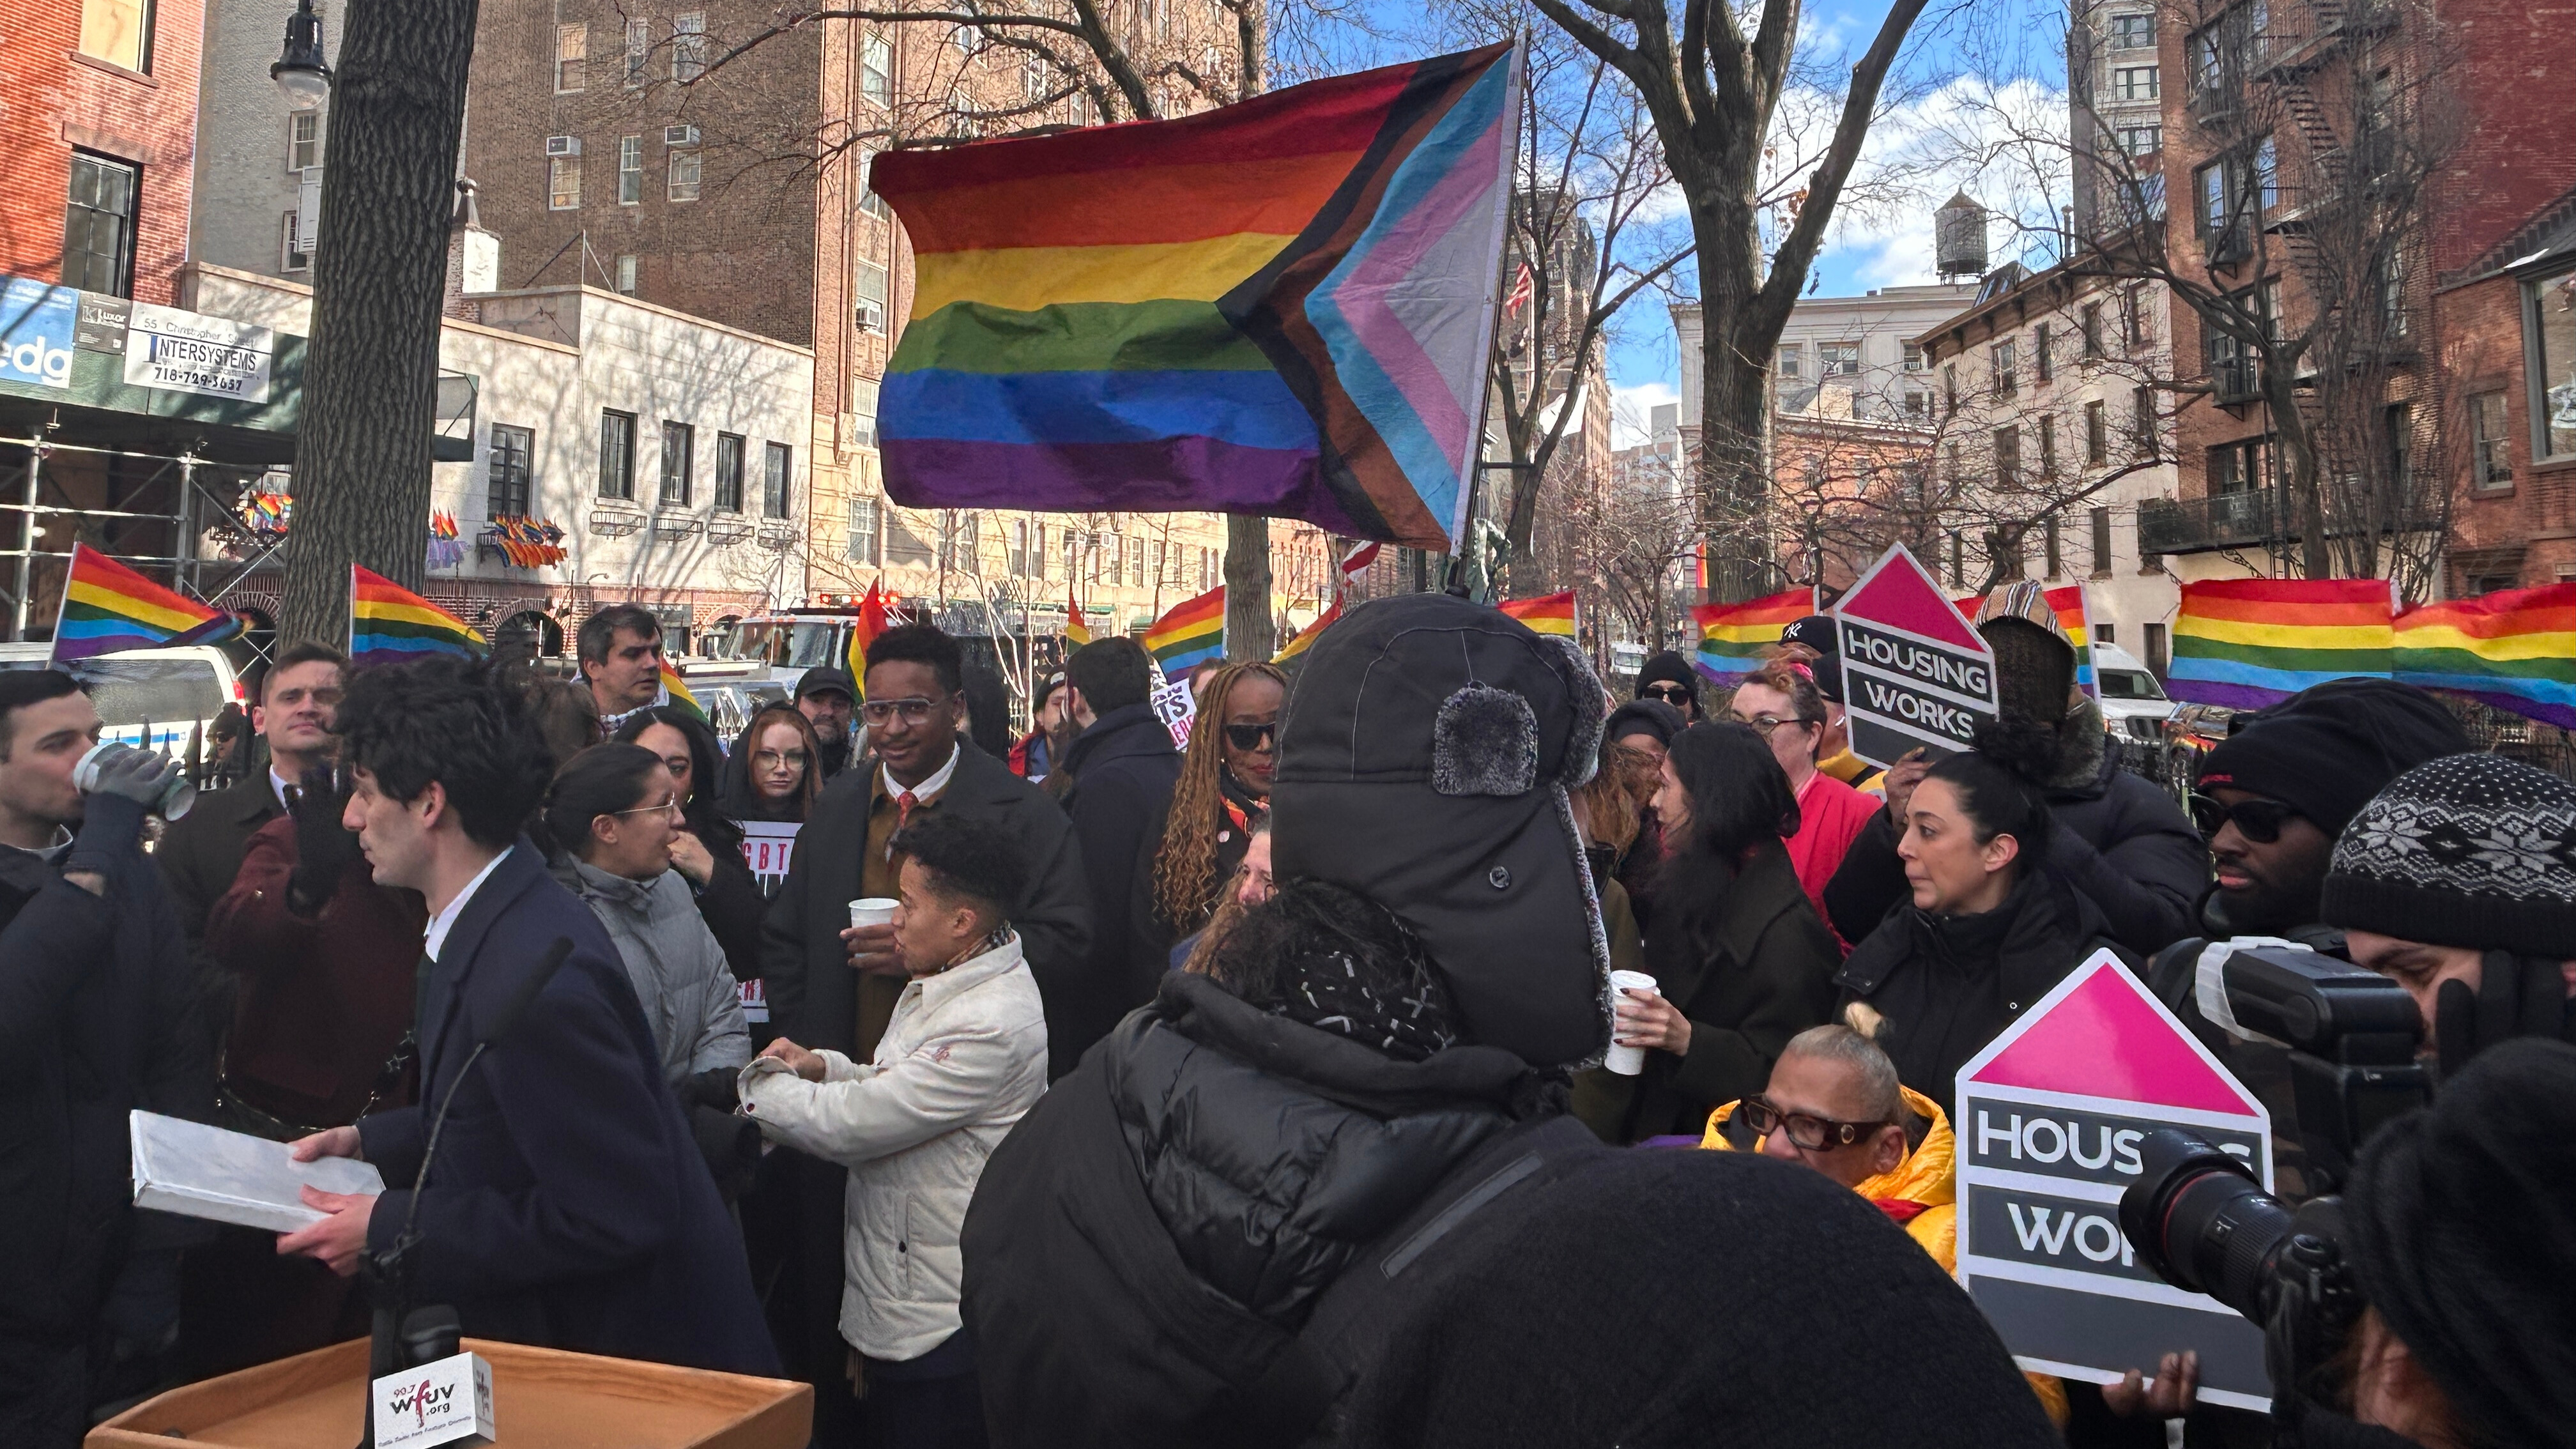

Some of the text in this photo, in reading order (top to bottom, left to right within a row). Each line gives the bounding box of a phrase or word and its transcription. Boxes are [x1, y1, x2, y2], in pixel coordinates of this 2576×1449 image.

[143, 334, 257, 371] INTERSYSTEMS
[144, 318, 158, 329] 55
[166, 322, 222, 341] Christopher
[1848, 629, 1988, 694] HOUSING
[1154, 694, 1188, 725] TS
[1864, 680, 1975, 739] WORKS
[1977, 1110, 2253, 1176] HOUS
[2006, 1202, 2135, 1267] WO
[426, 1402, 450, 1416] .org
